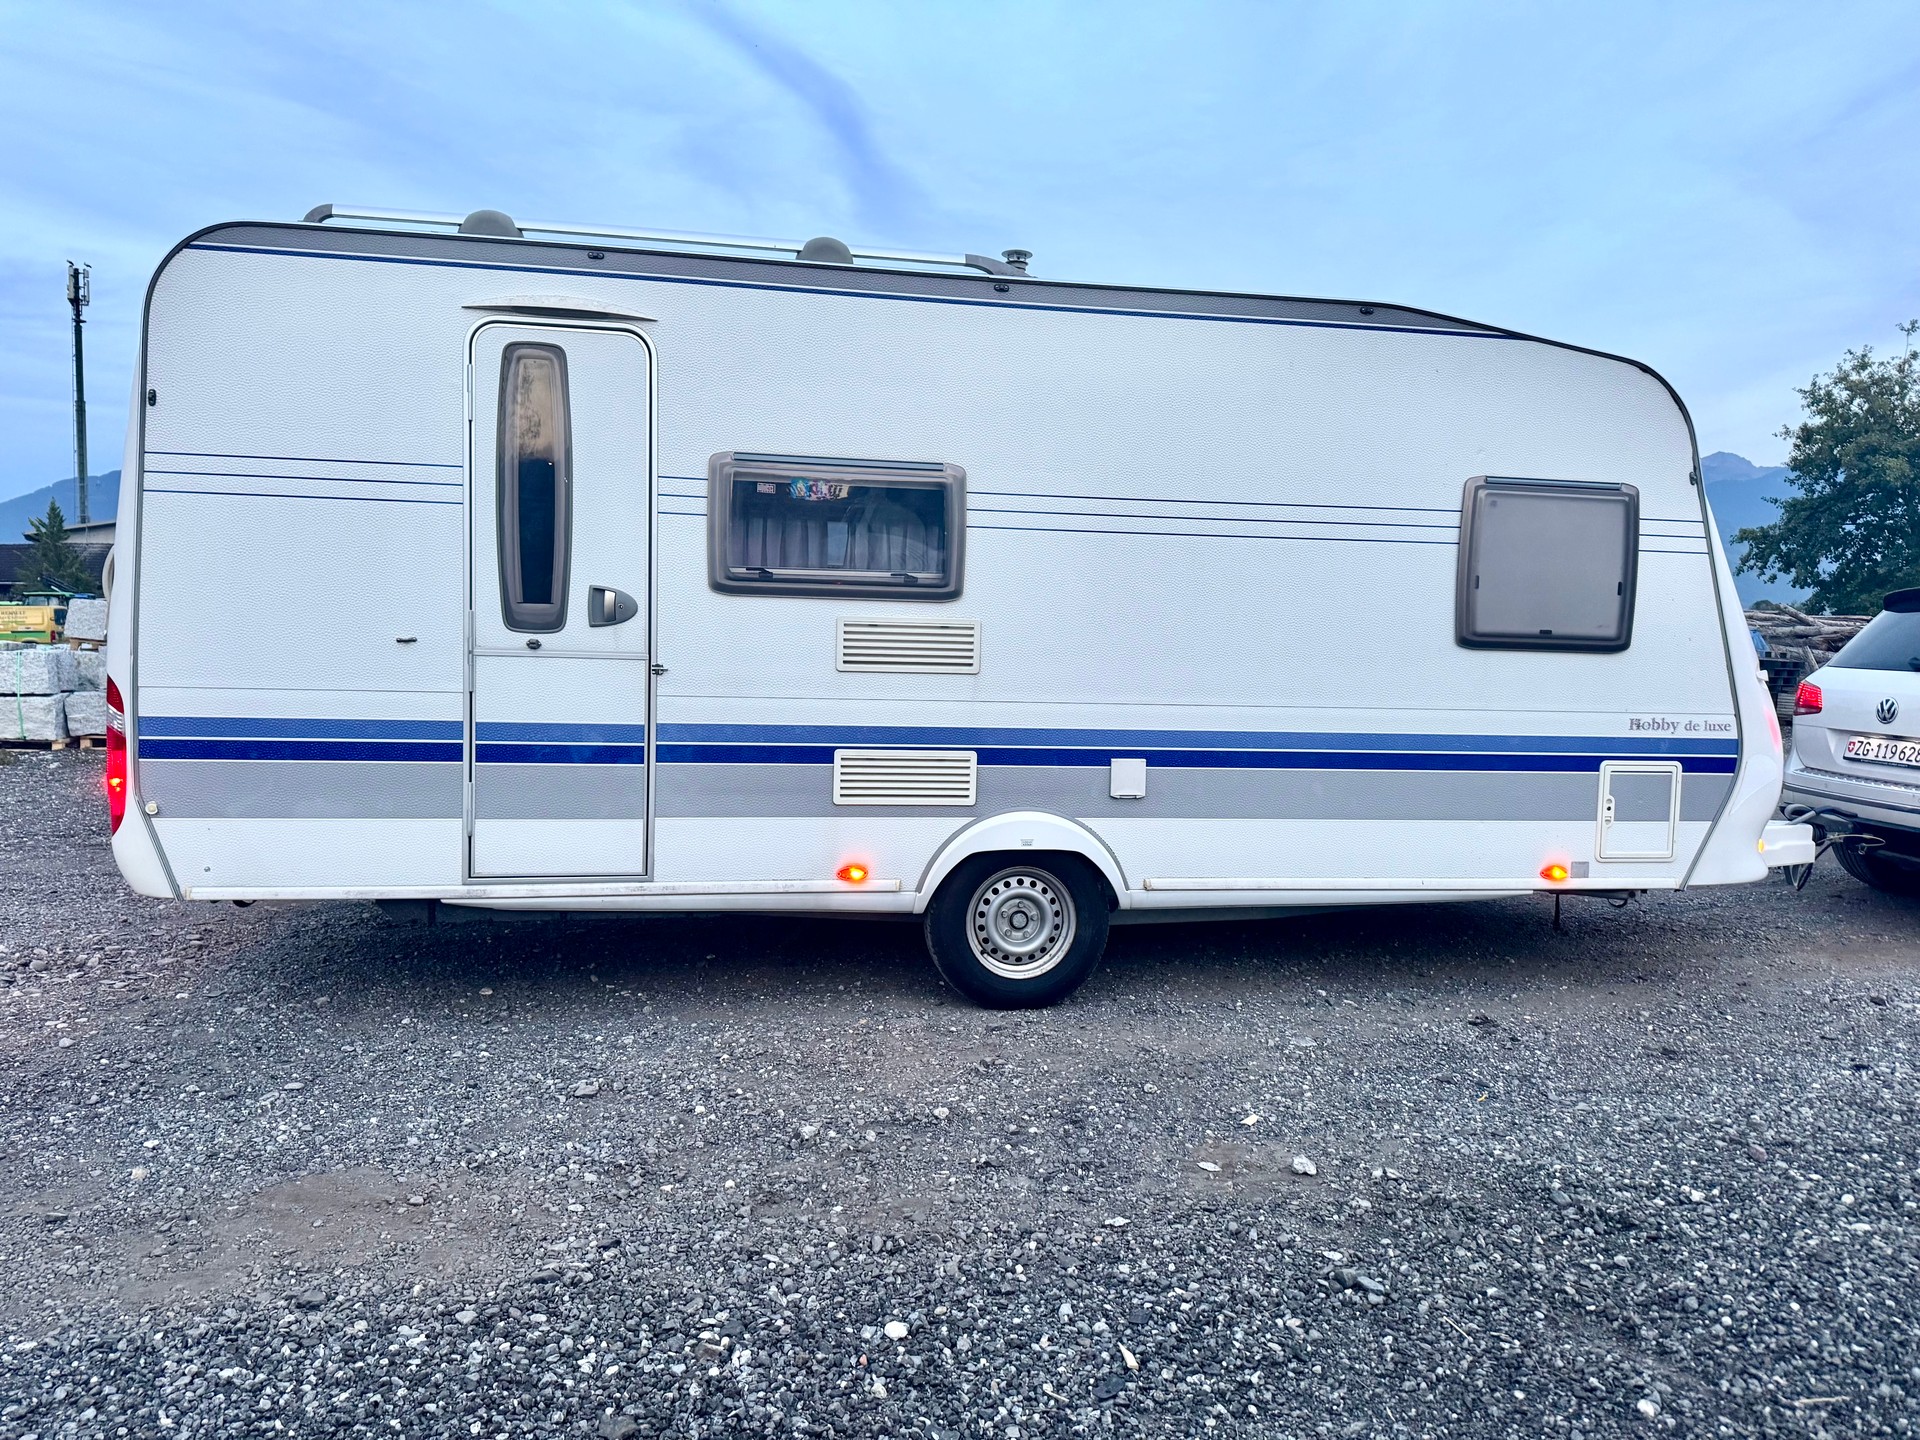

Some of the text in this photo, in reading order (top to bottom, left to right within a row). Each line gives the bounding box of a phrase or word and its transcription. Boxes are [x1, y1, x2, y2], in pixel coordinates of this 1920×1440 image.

[1628, 718, 1732, 734] Hobby de luxe
